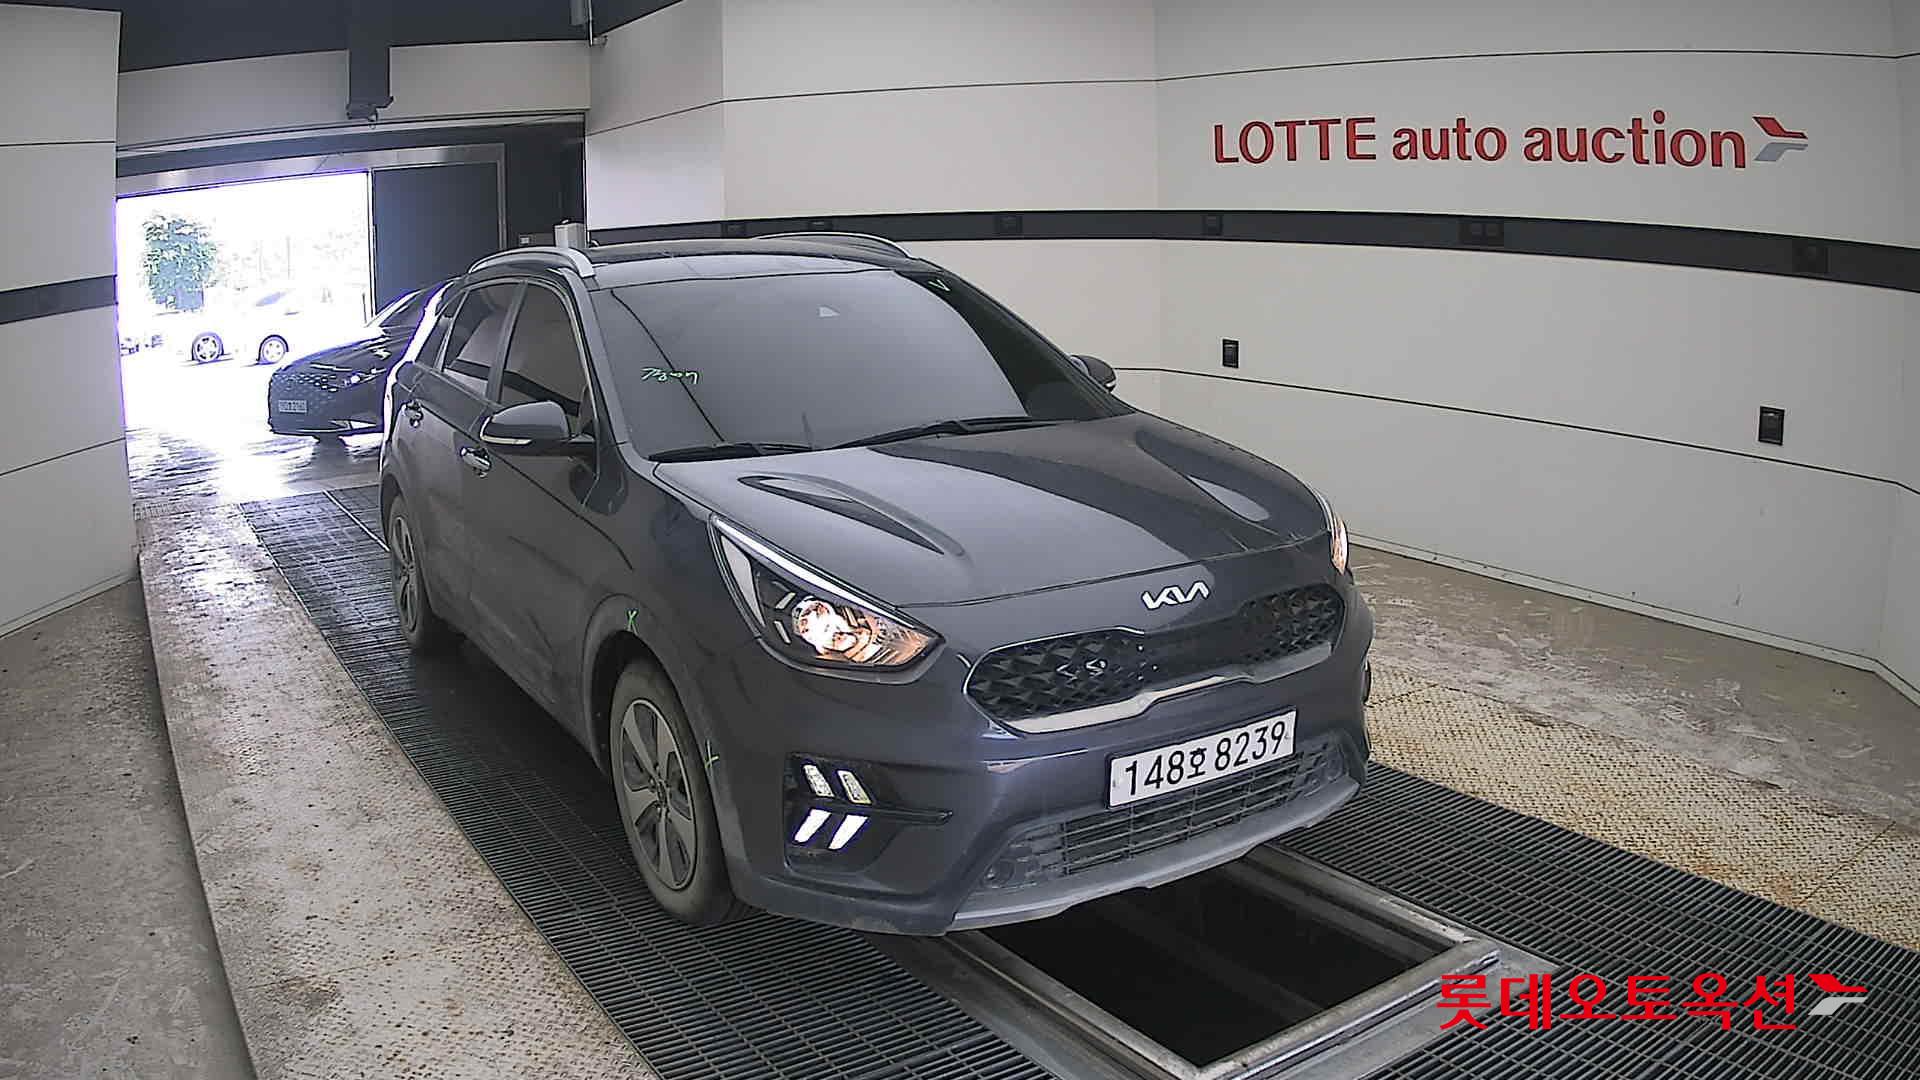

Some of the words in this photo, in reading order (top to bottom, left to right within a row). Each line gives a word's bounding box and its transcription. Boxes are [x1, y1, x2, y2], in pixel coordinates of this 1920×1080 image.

[1213, 117, 1377, 163] LOTTE
[1392, 117, 1508, 162] auto
[1523, 110, 1746, 169] auction
[1142, 581, 1209, 610] KIA
[1214, 719, 1286, 772] 8239
